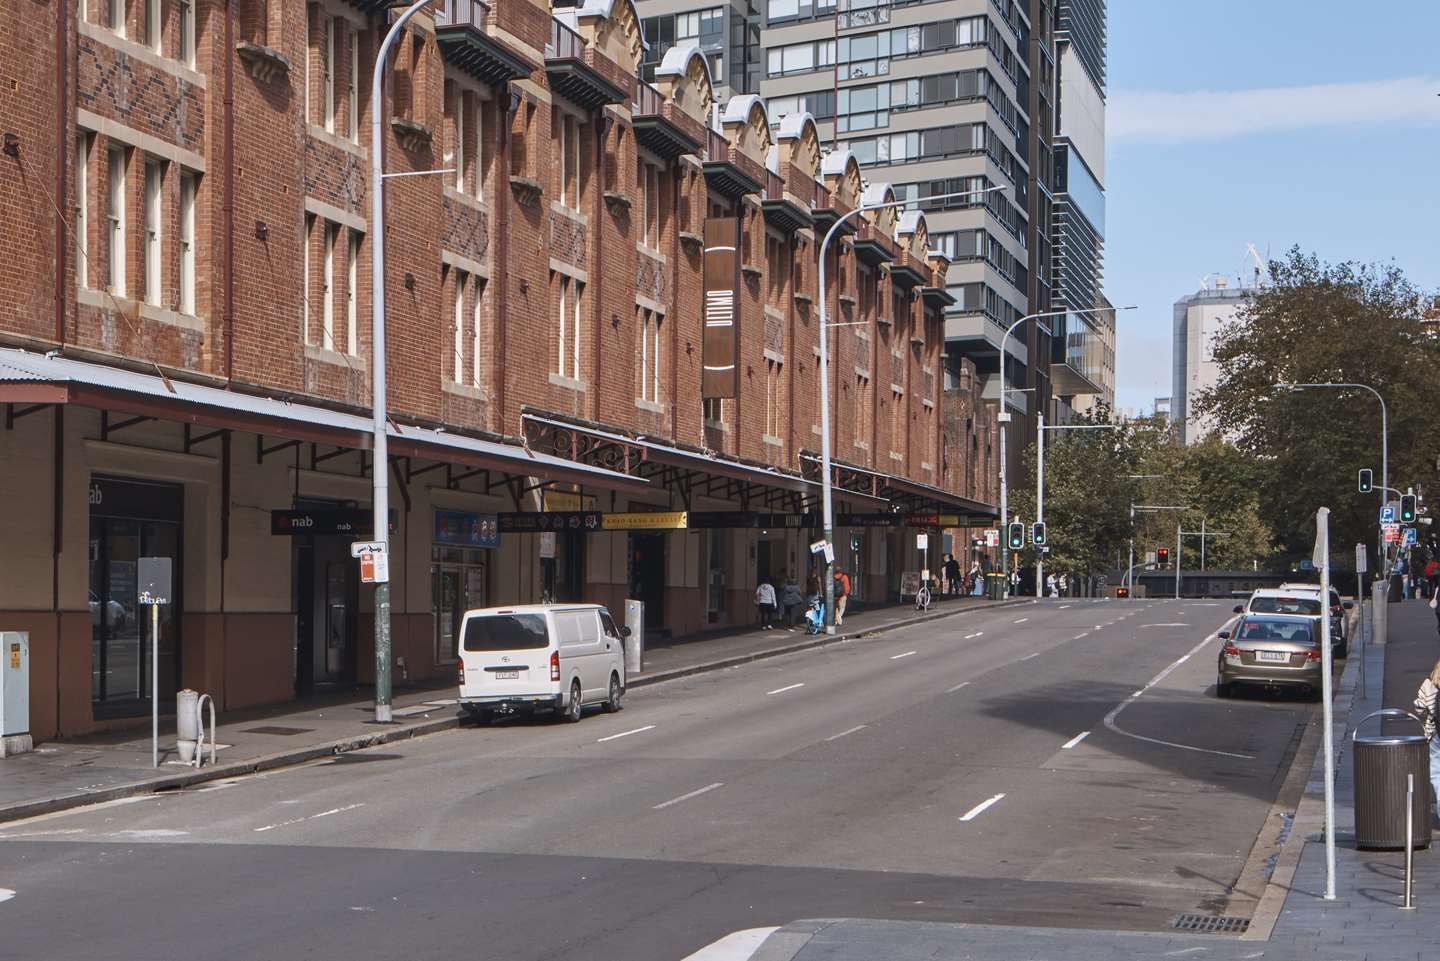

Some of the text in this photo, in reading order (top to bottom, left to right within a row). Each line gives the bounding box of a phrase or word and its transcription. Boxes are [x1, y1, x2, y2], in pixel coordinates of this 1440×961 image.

[706, 290, 733, 327] ULTIMO
[89, 484, 102, 505] ab
[1383, 508, 1392, 518] P
[292, 516, 313, 528] nab
